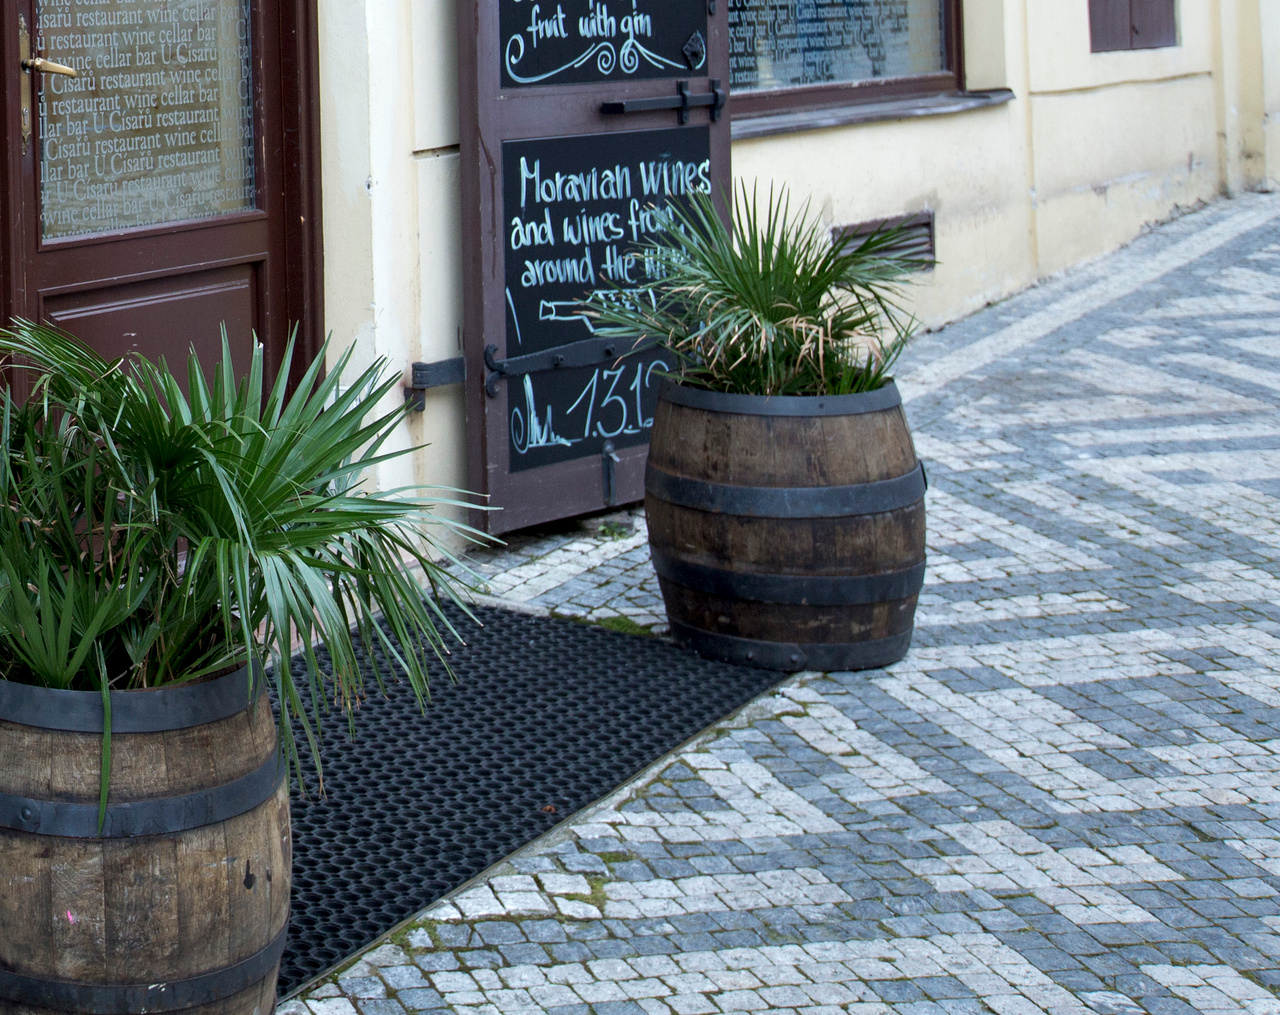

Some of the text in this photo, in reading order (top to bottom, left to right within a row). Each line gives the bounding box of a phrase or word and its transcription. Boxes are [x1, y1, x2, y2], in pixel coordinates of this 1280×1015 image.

[526, 2, 651, 48] fruit with gin
[520, 156, 712, 207] Moravian wines
[511, 207, 554, 249] and
[564, 209, 623, 245] wines
[521, 247, 595, 287] around
[601, 245, 636, 285] the
